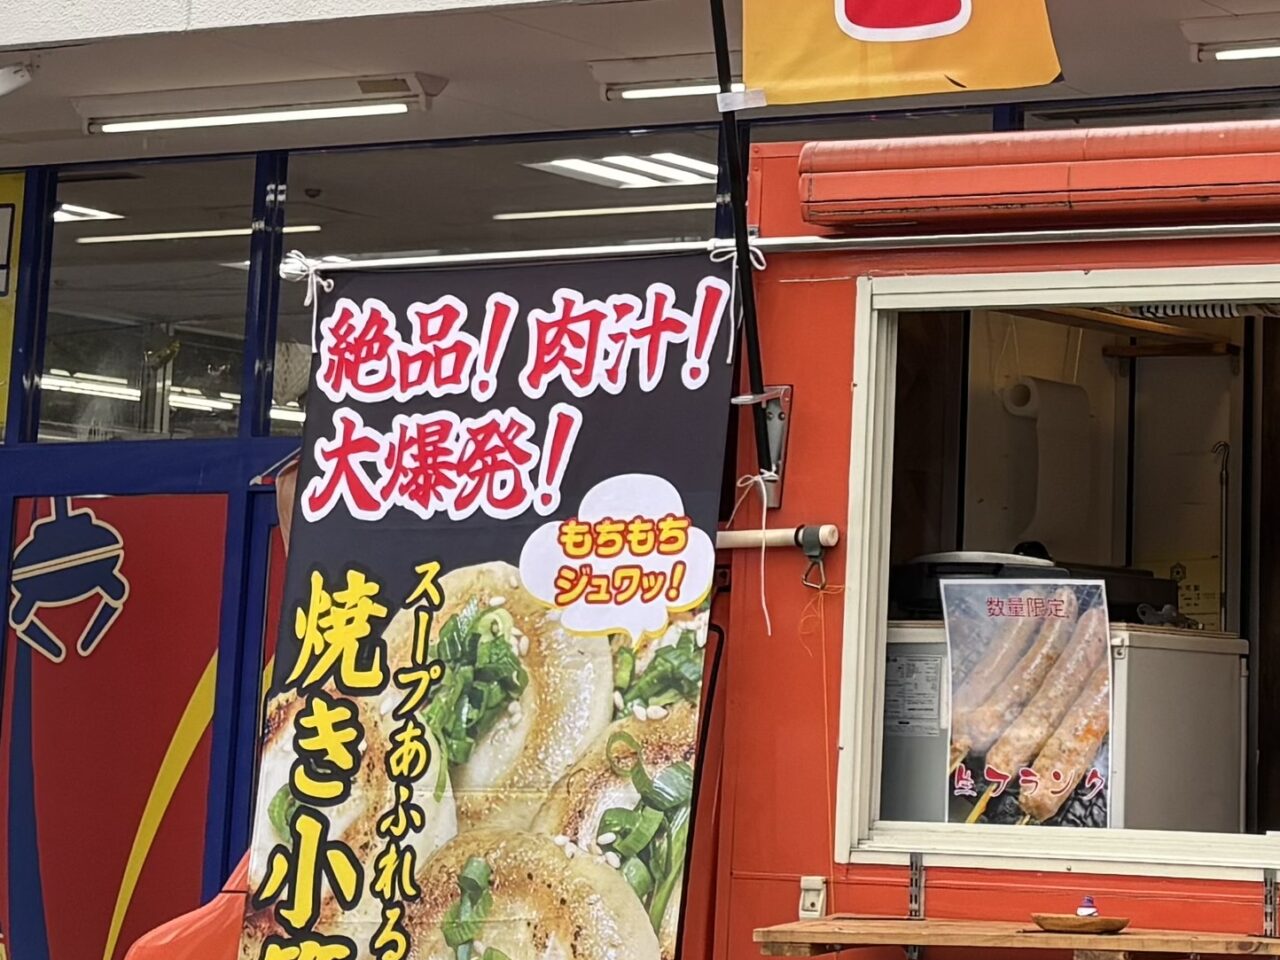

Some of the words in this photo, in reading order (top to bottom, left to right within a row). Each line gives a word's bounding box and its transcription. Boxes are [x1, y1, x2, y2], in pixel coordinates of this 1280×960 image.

[303, 402, 582, 524] 大爆発！
[557, 516, 691, 558] もちもち
[554, 564, 687, 606] ジュワッ！
[987, 597, 1066, 617] 数量限定
[954, 763, 1105, 800] 生フランク
